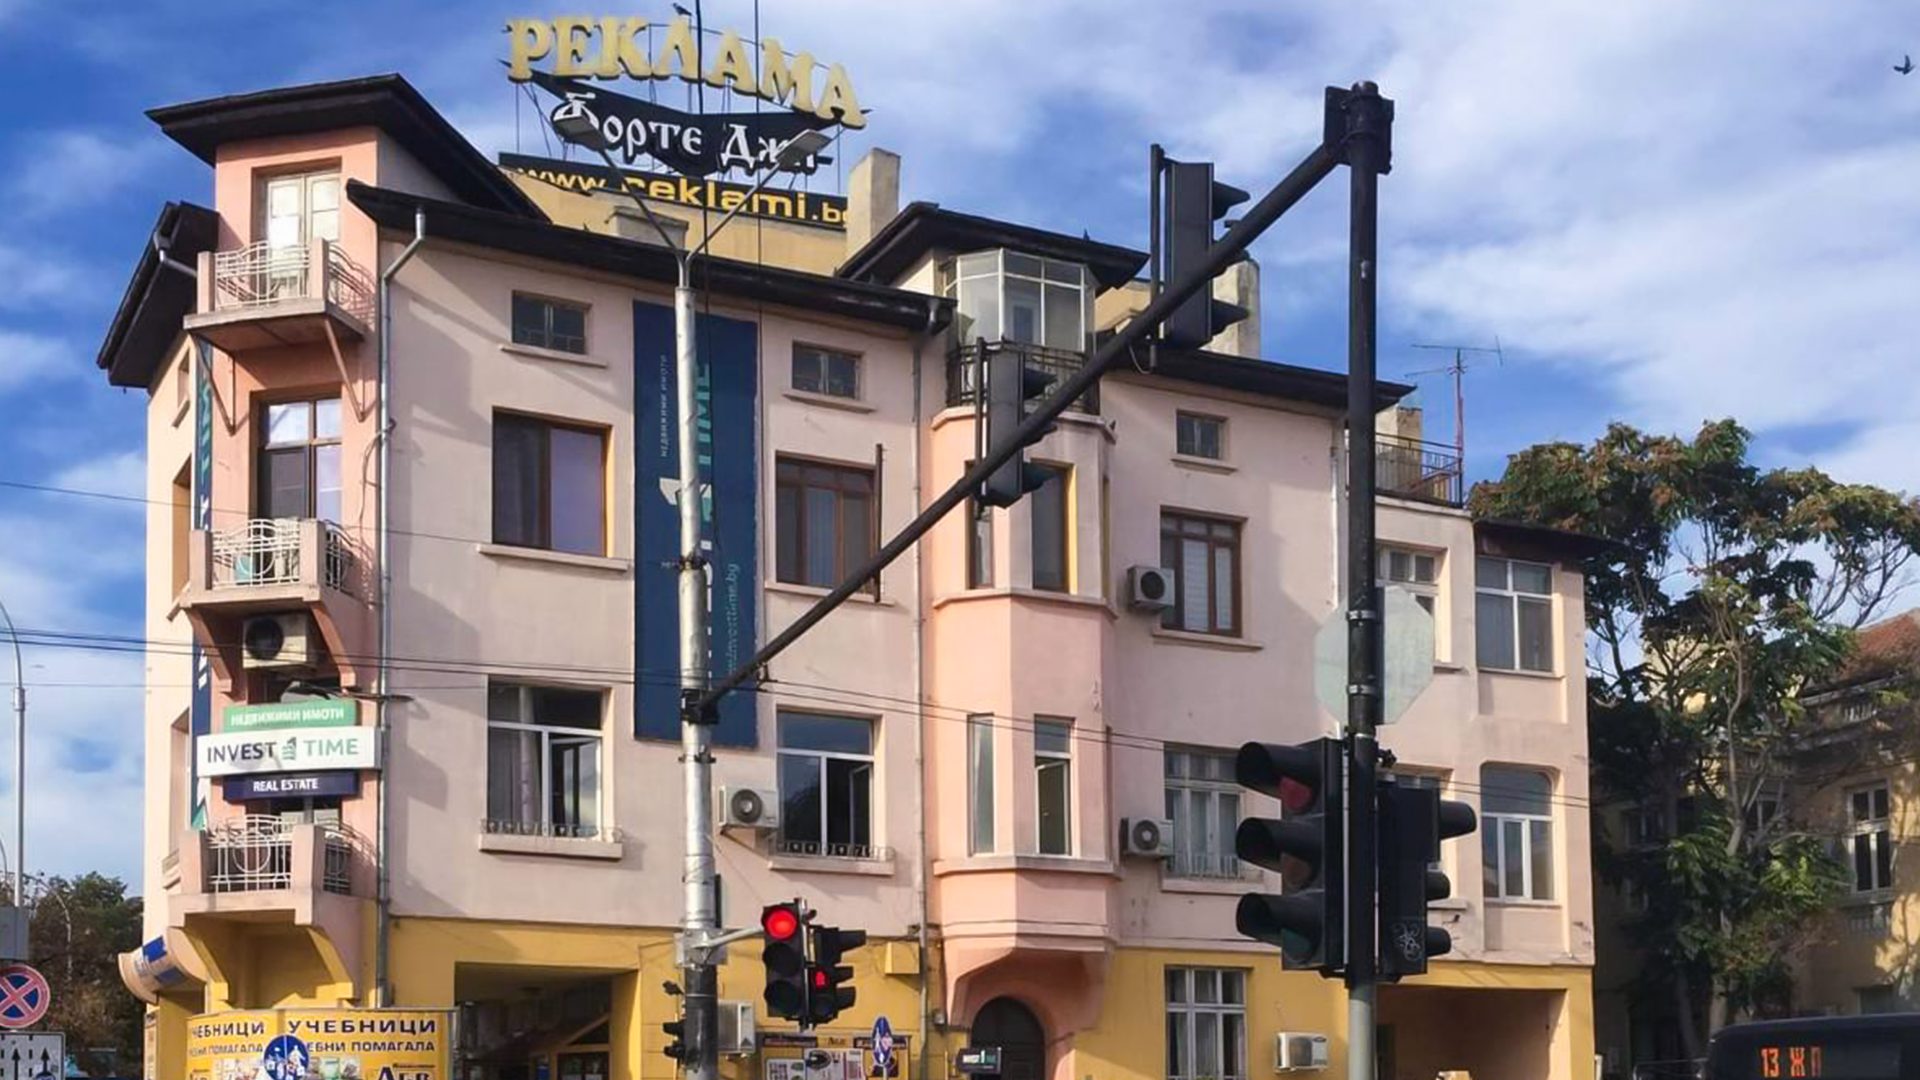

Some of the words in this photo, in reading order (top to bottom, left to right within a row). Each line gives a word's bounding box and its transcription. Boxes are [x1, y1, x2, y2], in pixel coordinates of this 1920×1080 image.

[506, 15, 868, 130] РЕКЛАМА
[720, 123, 815, 170] Дж
[207, 742, 277, 764] INVEST
[303, 737, 360, 757] TIME
[253, 779, 279, 792] REAL
[281, 777, 319, 791] ESTATE
[288, 1019, 436, 1035] УЧЕБНИЦИ
[307, 1041, 346, 1052] ЕБНИ
[351, 1041, 436, 1052] ПОМАГАЛА
[1761, 1048, 1779, 1077] 13
